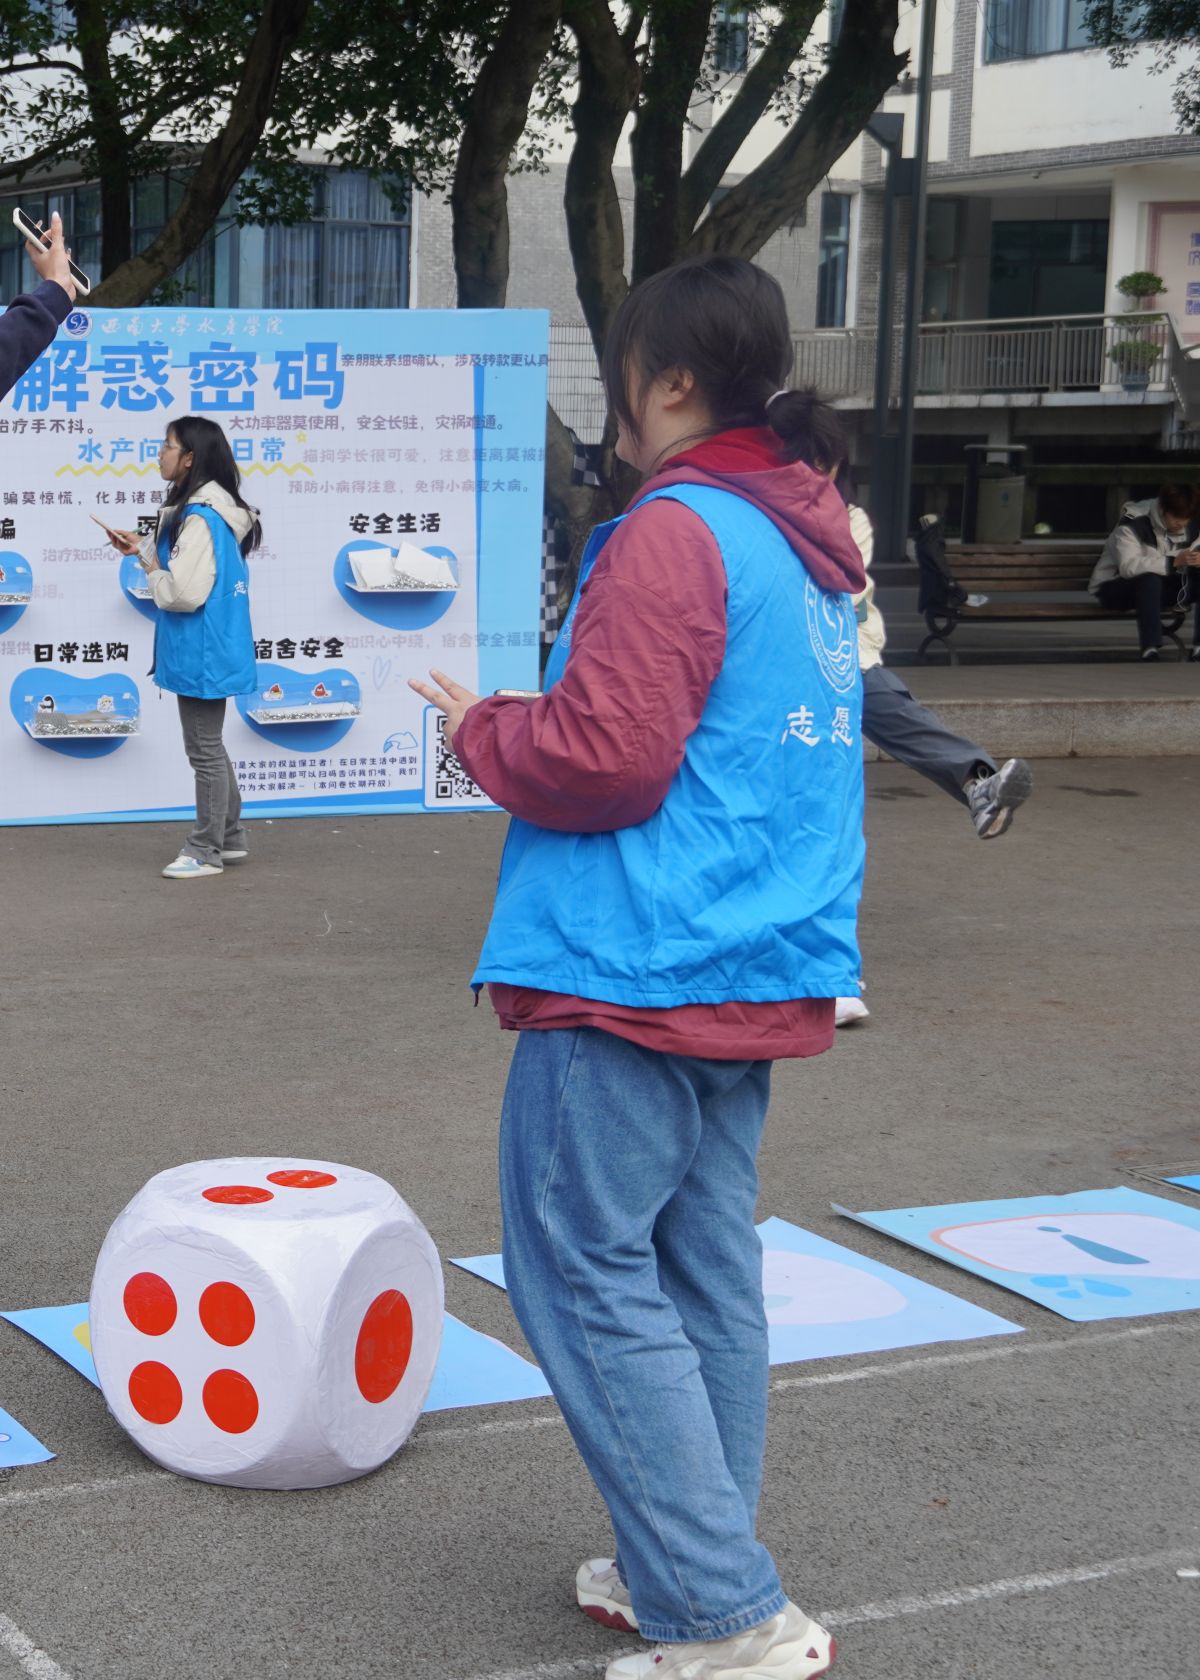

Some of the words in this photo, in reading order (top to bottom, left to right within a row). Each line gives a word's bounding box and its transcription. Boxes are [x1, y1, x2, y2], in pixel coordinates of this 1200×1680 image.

[11, 340, 345, 413] 解惑密码
[349, 512, 441, 534] 安全生活
[33, 641, 129, 664] 日常选购
[253, 637, 345, 660] 宿舍安全
[780, 704, 854, 748] 志愿
